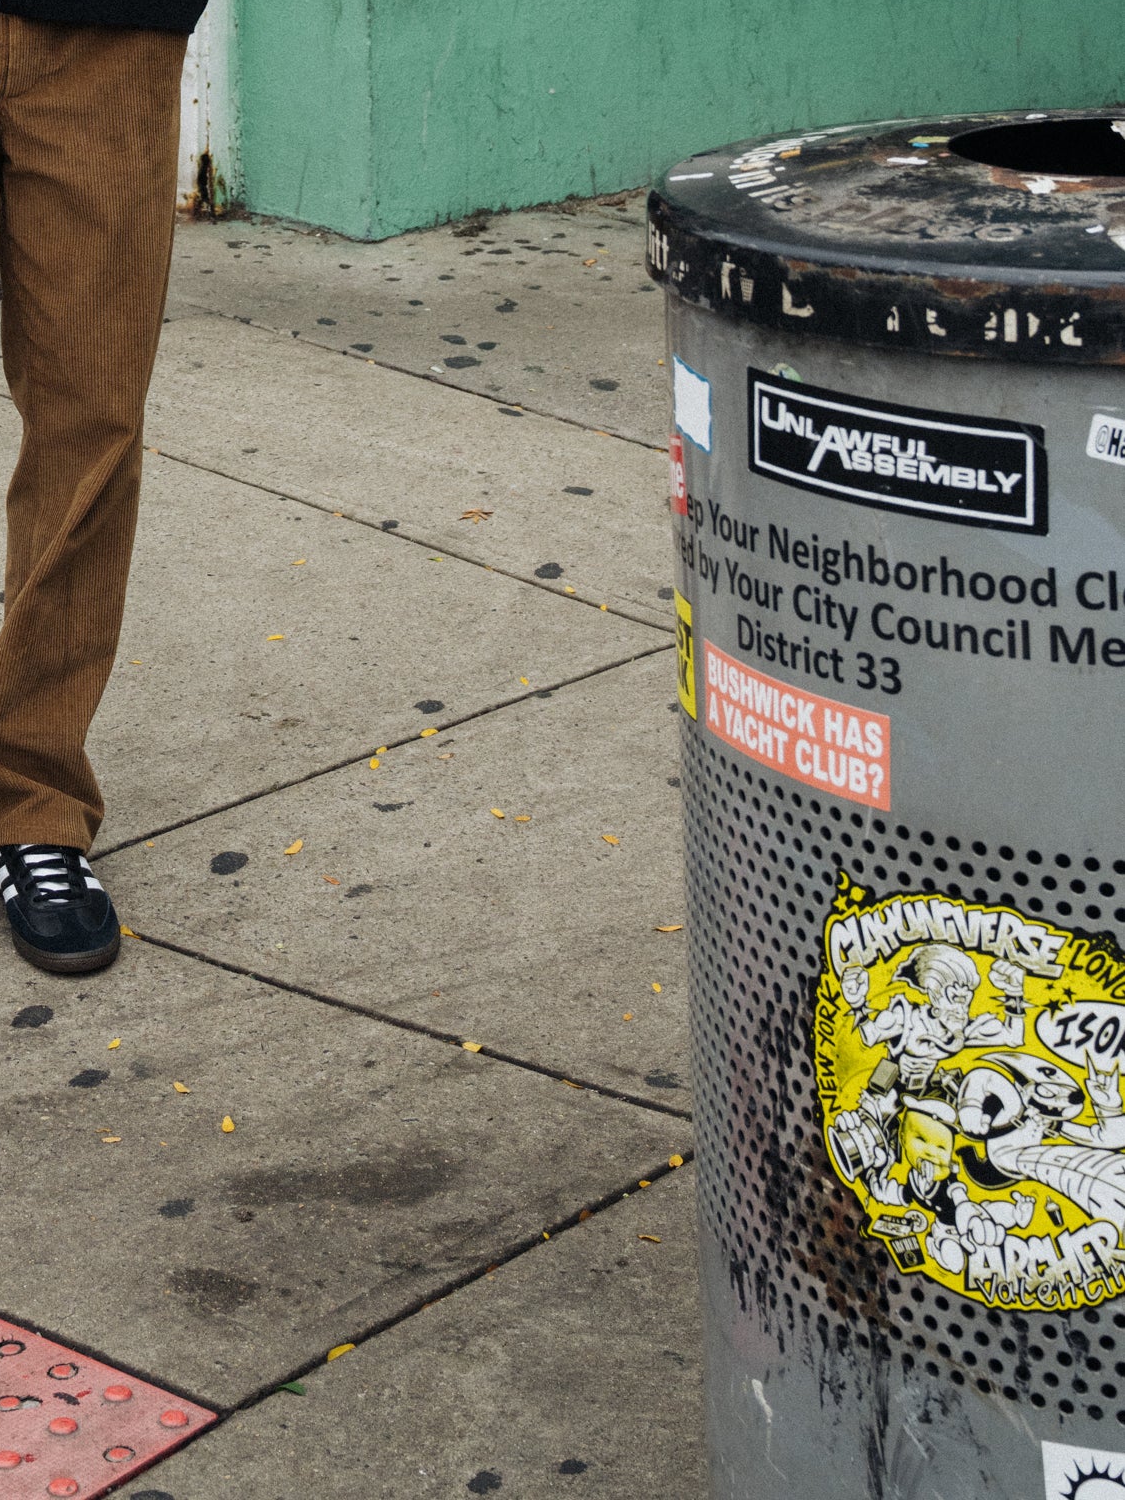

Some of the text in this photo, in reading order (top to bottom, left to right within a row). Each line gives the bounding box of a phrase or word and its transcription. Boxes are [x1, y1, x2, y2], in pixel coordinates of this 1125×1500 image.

[807, 426, 1022, 495] ASSEMBLY
[686, 492, 1125, 612] ep Your Neighborhood Cl
[699, 540, 720, 594] by
[725, 556, 782, 612] Your
[792, 583, 859, 642] City
[871, 602, 1030, 661] Council
[737, 613, 903, 695] District 33
[707, 652, 884, 759] BUSHWICK HAS
[708, 698, 885, 799] A YACHT CLUB?
[829, 899, 1067, 981] CLAYUNIVERSE
[819, 980, 844, 1112] NEW YORK
[967, 1219, 1125, 1291] ARCHER
